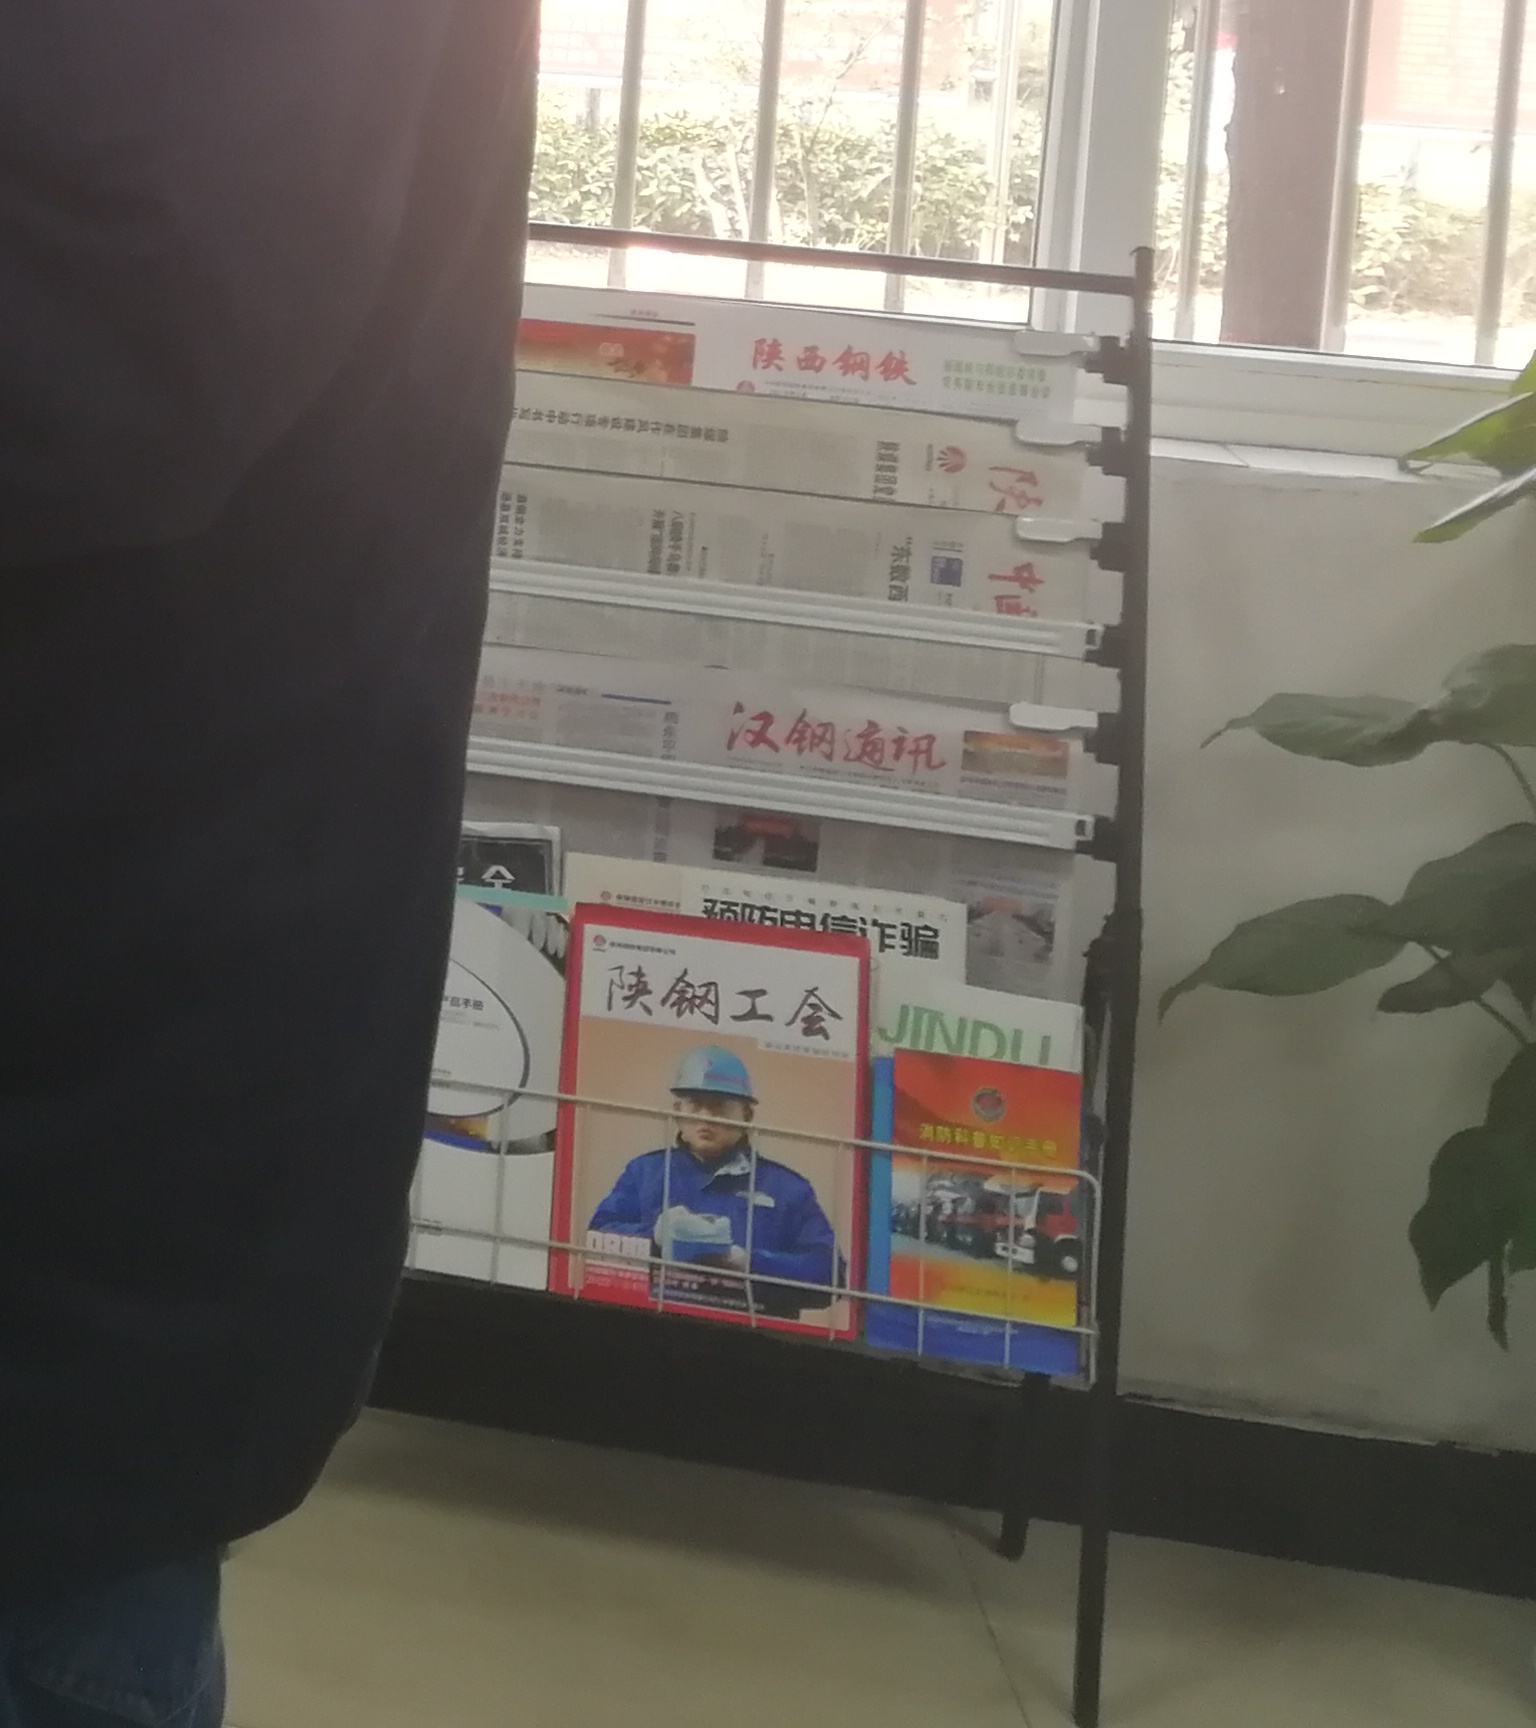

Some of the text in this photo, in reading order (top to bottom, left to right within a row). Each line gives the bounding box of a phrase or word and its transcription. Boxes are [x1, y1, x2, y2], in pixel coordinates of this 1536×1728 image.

[751, 336, 918, 387] 陕西钢铁
[606, 964, 843, 1041] 陕钢工会
